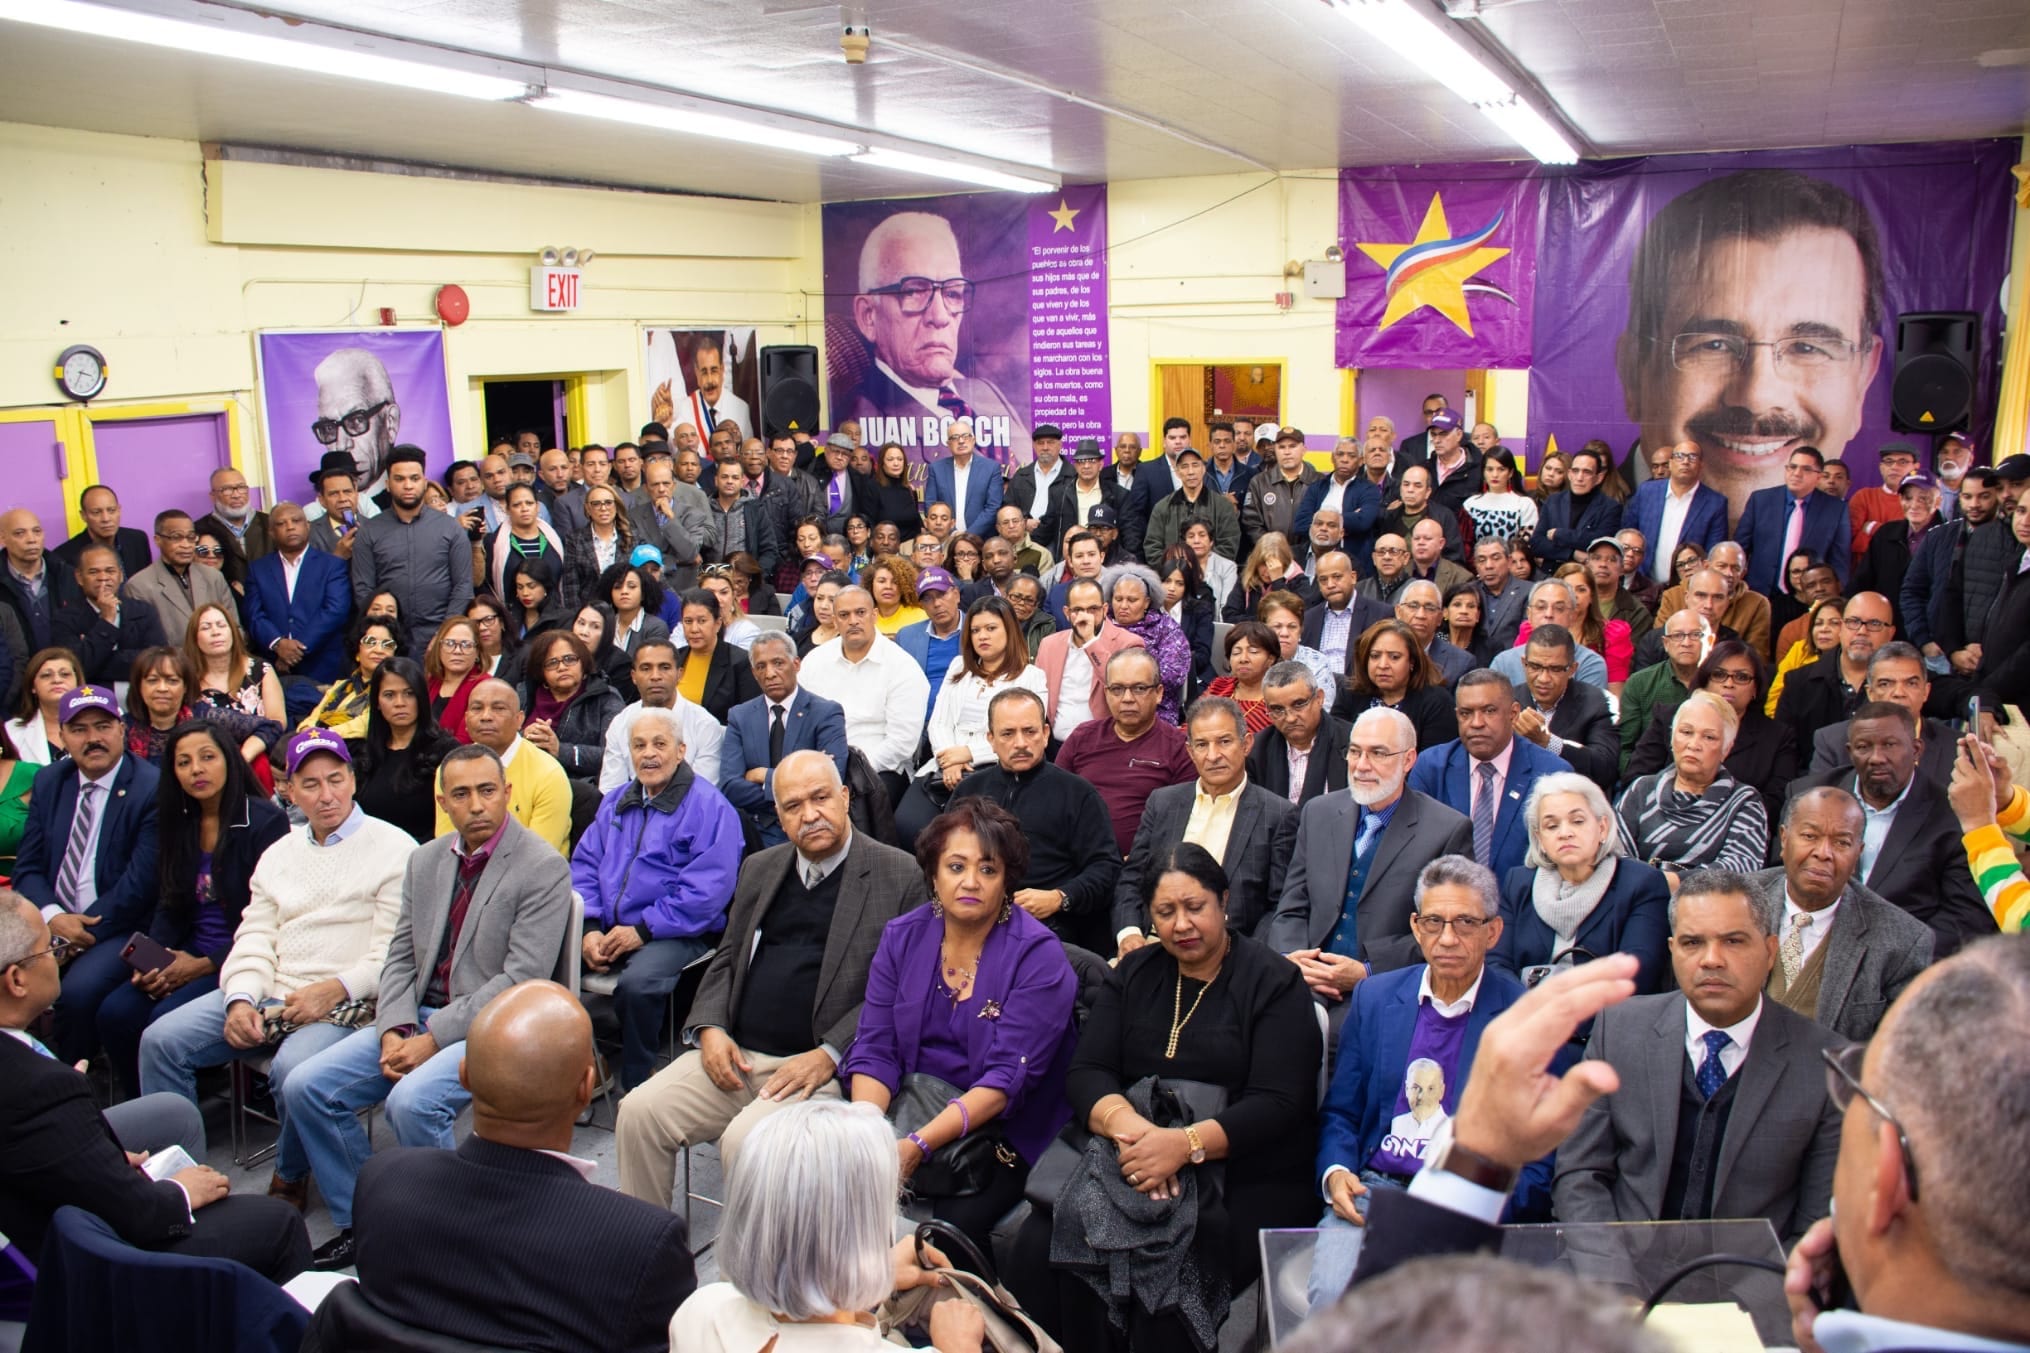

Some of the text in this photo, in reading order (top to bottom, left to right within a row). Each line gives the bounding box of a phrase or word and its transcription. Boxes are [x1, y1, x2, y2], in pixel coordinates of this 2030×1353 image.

[1042, 245, 1070, 256] porvenir
[1070, 244, 1079, 253] de
[1080, 244, 1090, 253] los
[1084, 258, 1094, 266] de
[1045, 273, 1060, 283] hijos
[1061, 272, 1076, 281] más
[1077, 273, 1089, 282] que
[1091, 271, 1100, 280] de
[547, 273, 579, 308] EXIT
[1032, 285, 1091, 297] sus padres, de los
[1032, 298, 1090, 311] que viven y de los
[1032, 315, 1045, 324] que
[1065, 312, 1080, 323] vivir,
[1081, 312, 1097, 321] más
[1033, 326, 1097, 337] que de aquellos que
[1033, 340, 1103, 350] rindieron sus tareas y
[1043, 354, 1077, 363] marcharon
[1078, 354, 1091, 362] con
[1092, 352, 1103, 361] los
[1033, 367, 1103, 378] siglos. La obra buena
[1034, 380, 1104, 390] de los muertos, como
[1034, 396, 1042, 404] su
[1043, 394, 1059, 403] obra
[1060, 394, 1078, 404] mala,
[1034, 407, 1085, 418] propiedad de la
[859, 415, 1011, 447] JUAN BOCH
[1062, 421, 1077, 431] pero
[1078, 420, 1085, 429] la
[1086, 420, 1102, 429] obra
[1097, 435, 1106, 443] es
